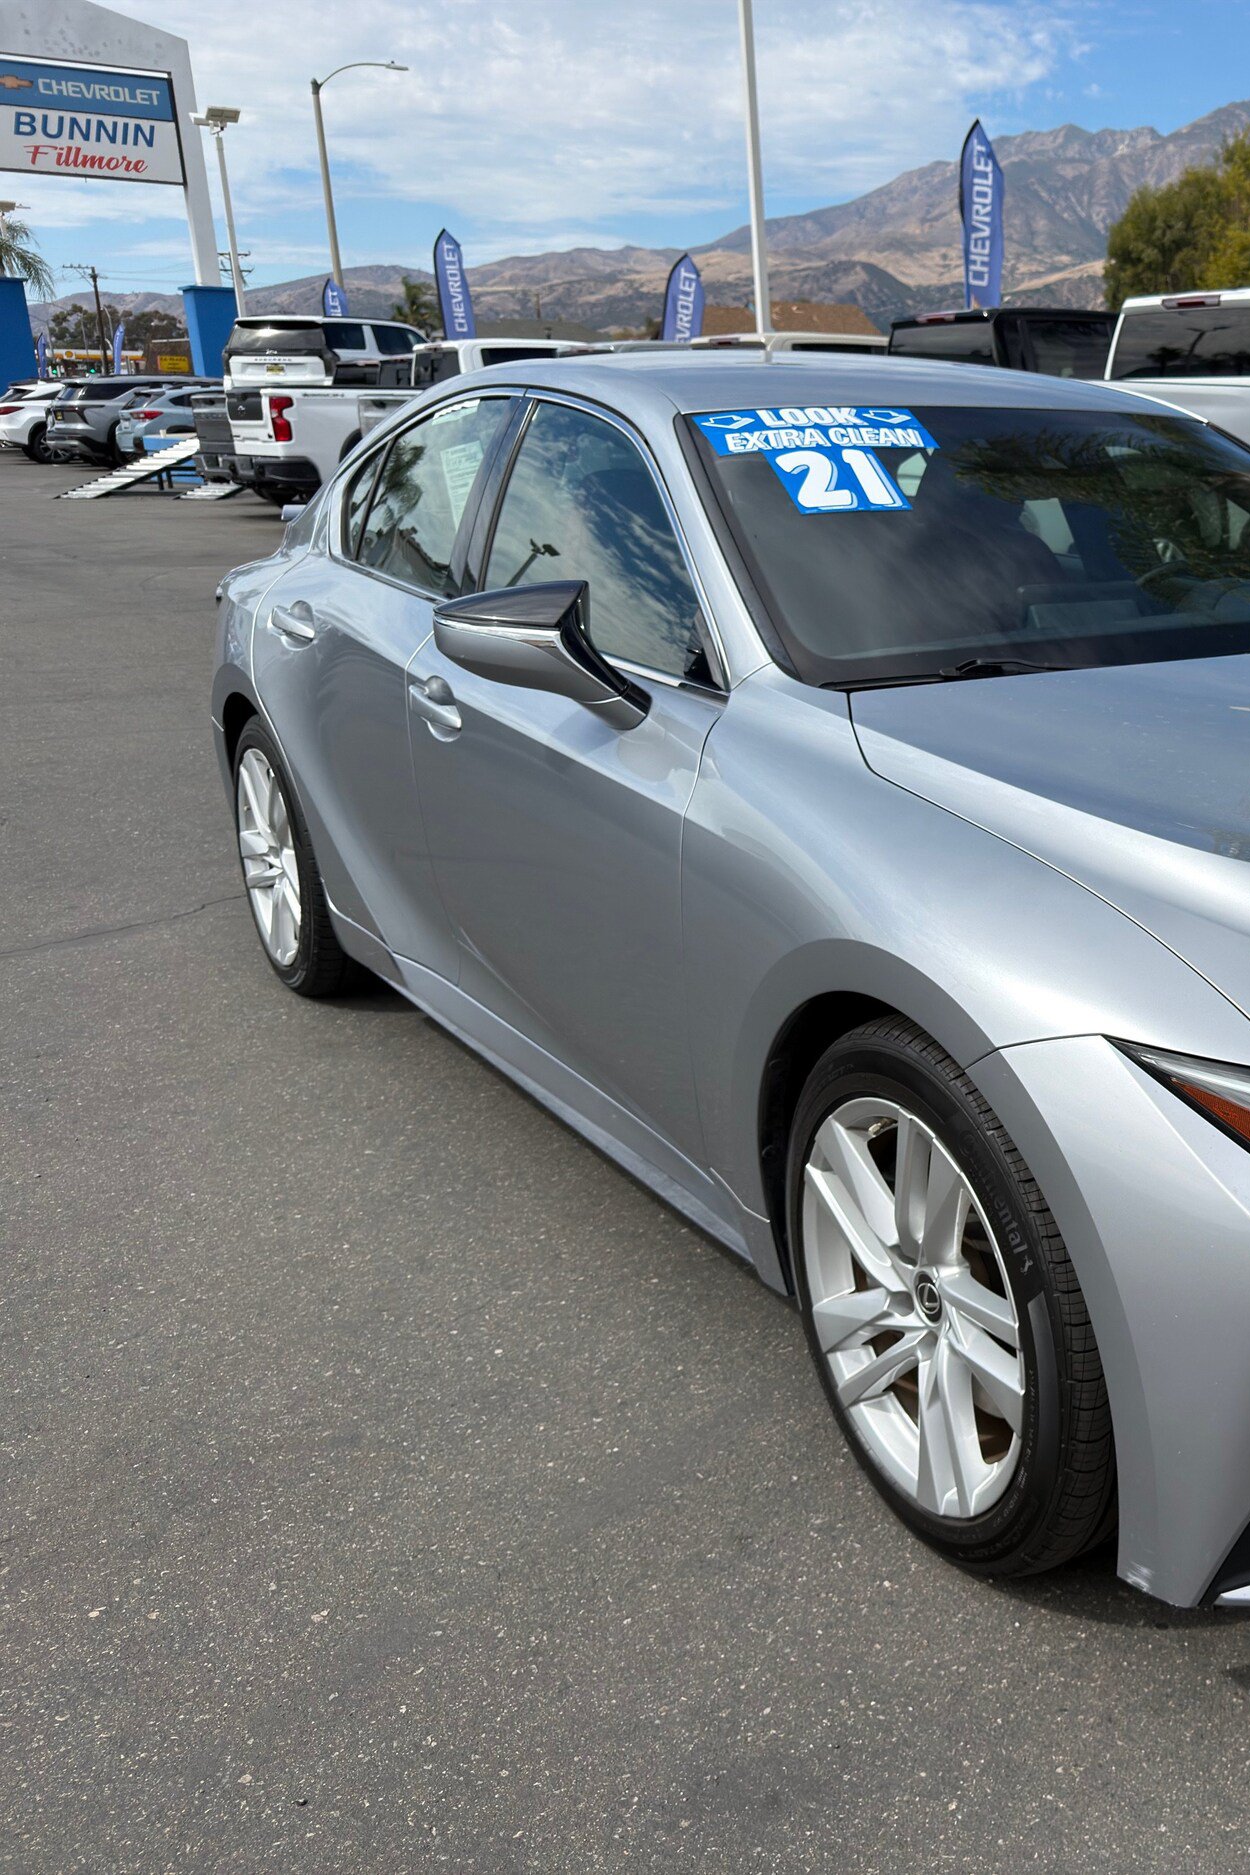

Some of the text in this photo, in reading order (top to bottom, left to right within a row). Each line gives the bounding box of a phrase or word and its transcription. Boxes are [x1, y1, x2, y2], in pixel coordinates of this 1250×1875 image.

[37, 78, 160, 106] CHEVROLET
[14, 111, 155, 148] BUNNIN
[23, 144, 148, 174] Fillmore
[968, 138, 994, 287] CHEVROLET
[327, 288, 343, 316] LET
[443, 241, 469, 333] CHEVROLET
[755, 407, 868, 428] LOOK
[725, 427, 925, 452] EXTRA CLEAN
[775, 448, 903, 510] 21
